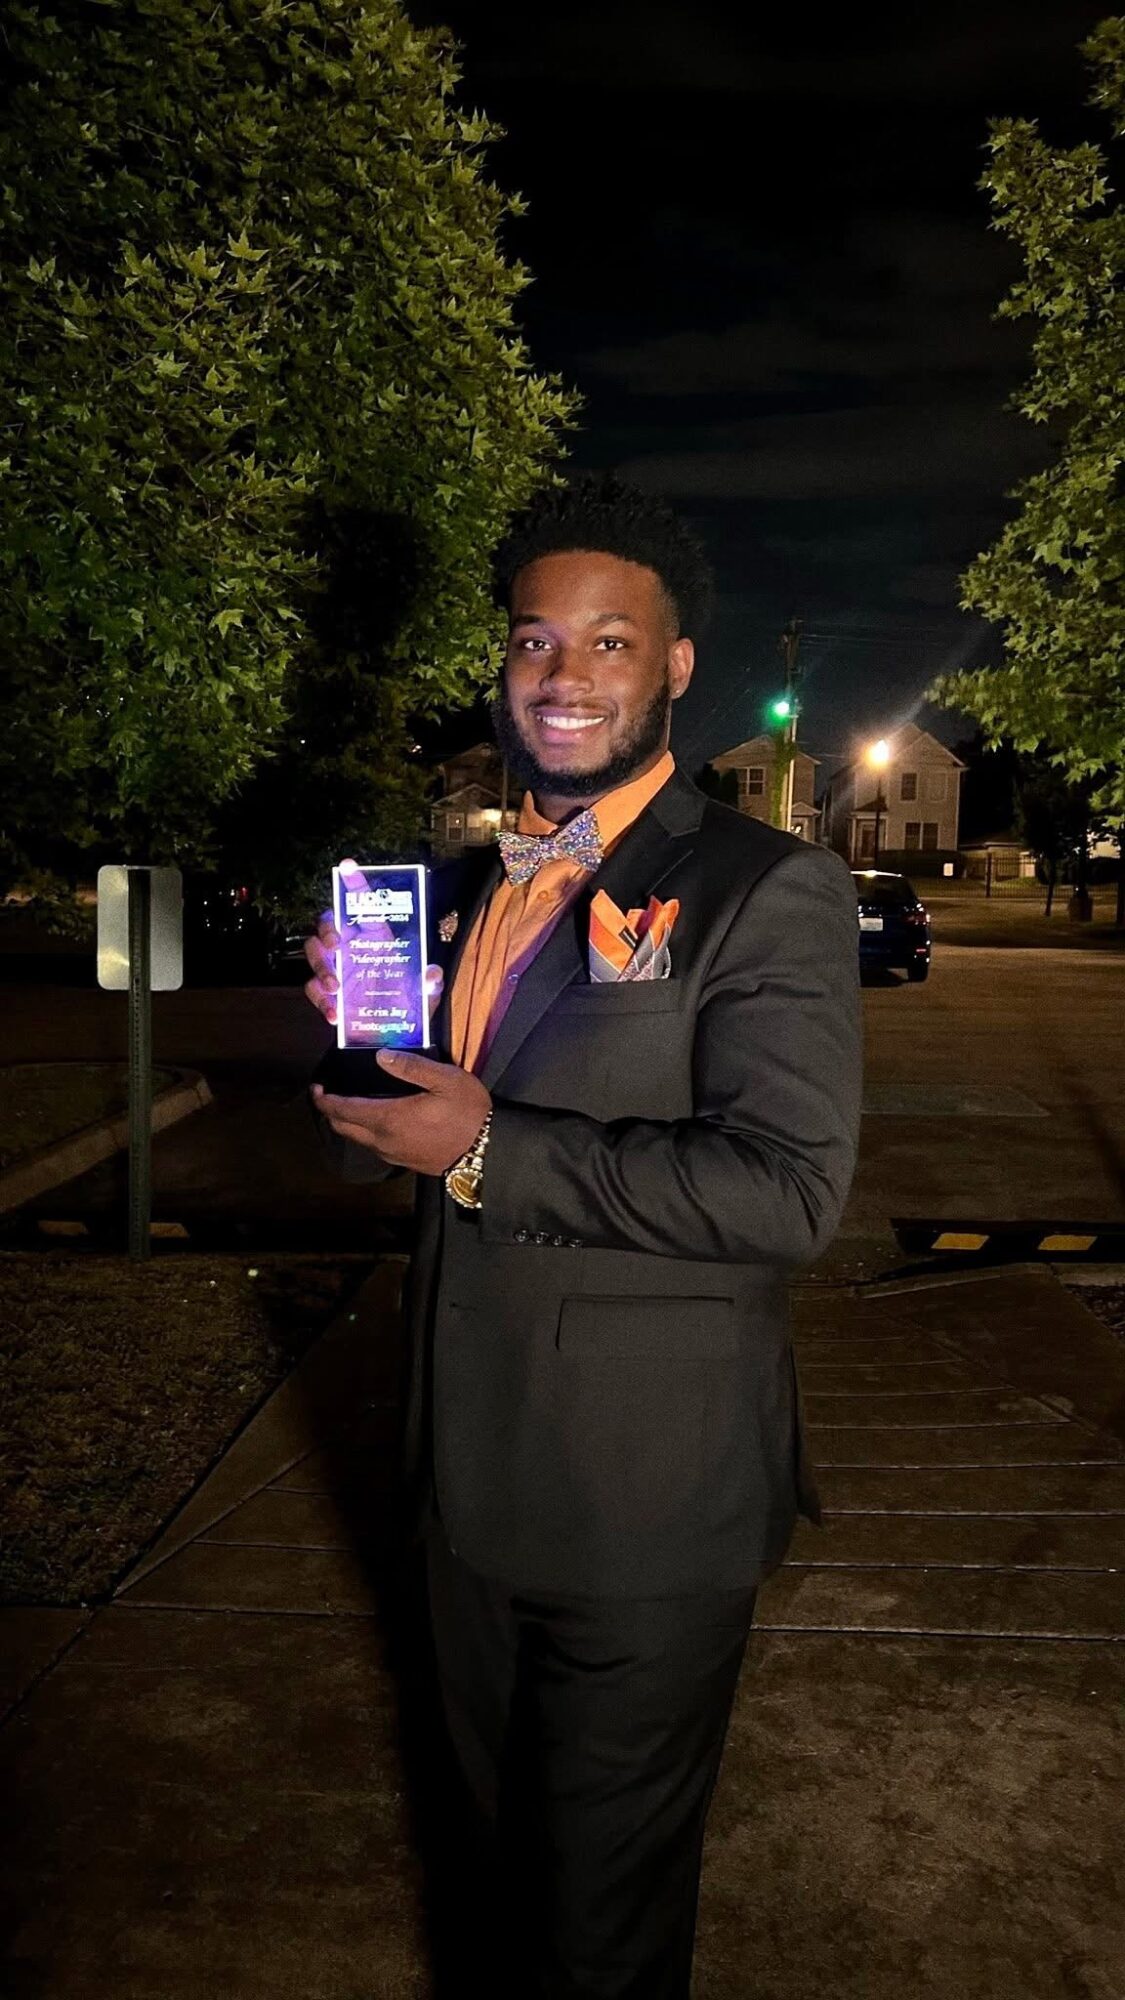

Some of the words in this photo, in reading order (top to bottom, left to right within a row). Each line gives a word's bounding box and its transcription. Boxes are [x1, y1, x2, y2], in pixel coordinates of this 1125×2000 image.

[349, 938, 410, 951] Photographer
[350, 953, 411, 966] Videographer
[356, 969, 365, 981] of
[367, 970, 381, 978] the
[384, 969, 405, 980] Year
[358, 1006, 389, 1017] Kevin
[351, 1020, 416, 1033] Photography
